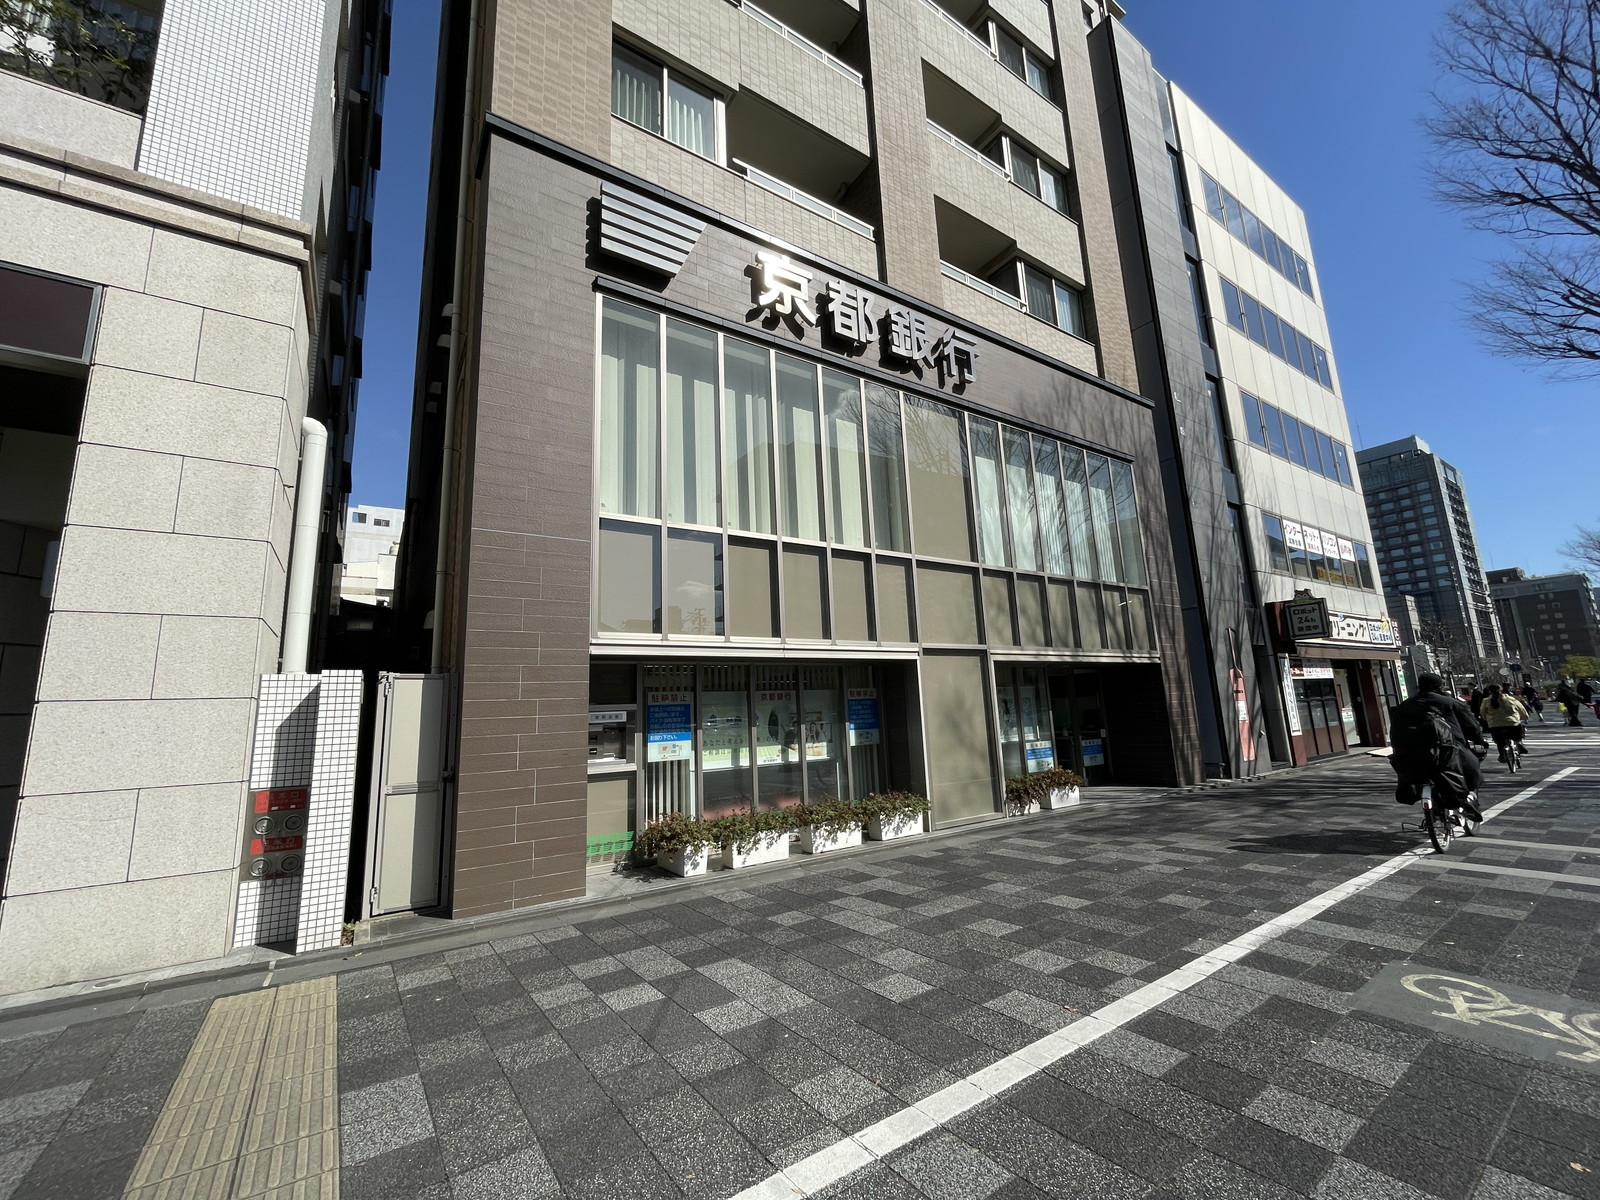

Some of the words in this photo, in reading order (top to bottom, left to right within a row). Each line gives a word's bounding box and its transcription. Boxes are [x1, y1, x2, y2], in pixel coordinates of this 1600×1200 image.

[756, 250, 980, 386] 京都銀行
[1292, 607, 1317, 616] ロボット
[1297, 616, 1316, 625] 24h
[761, 692, 791, 702] 京都銀行
